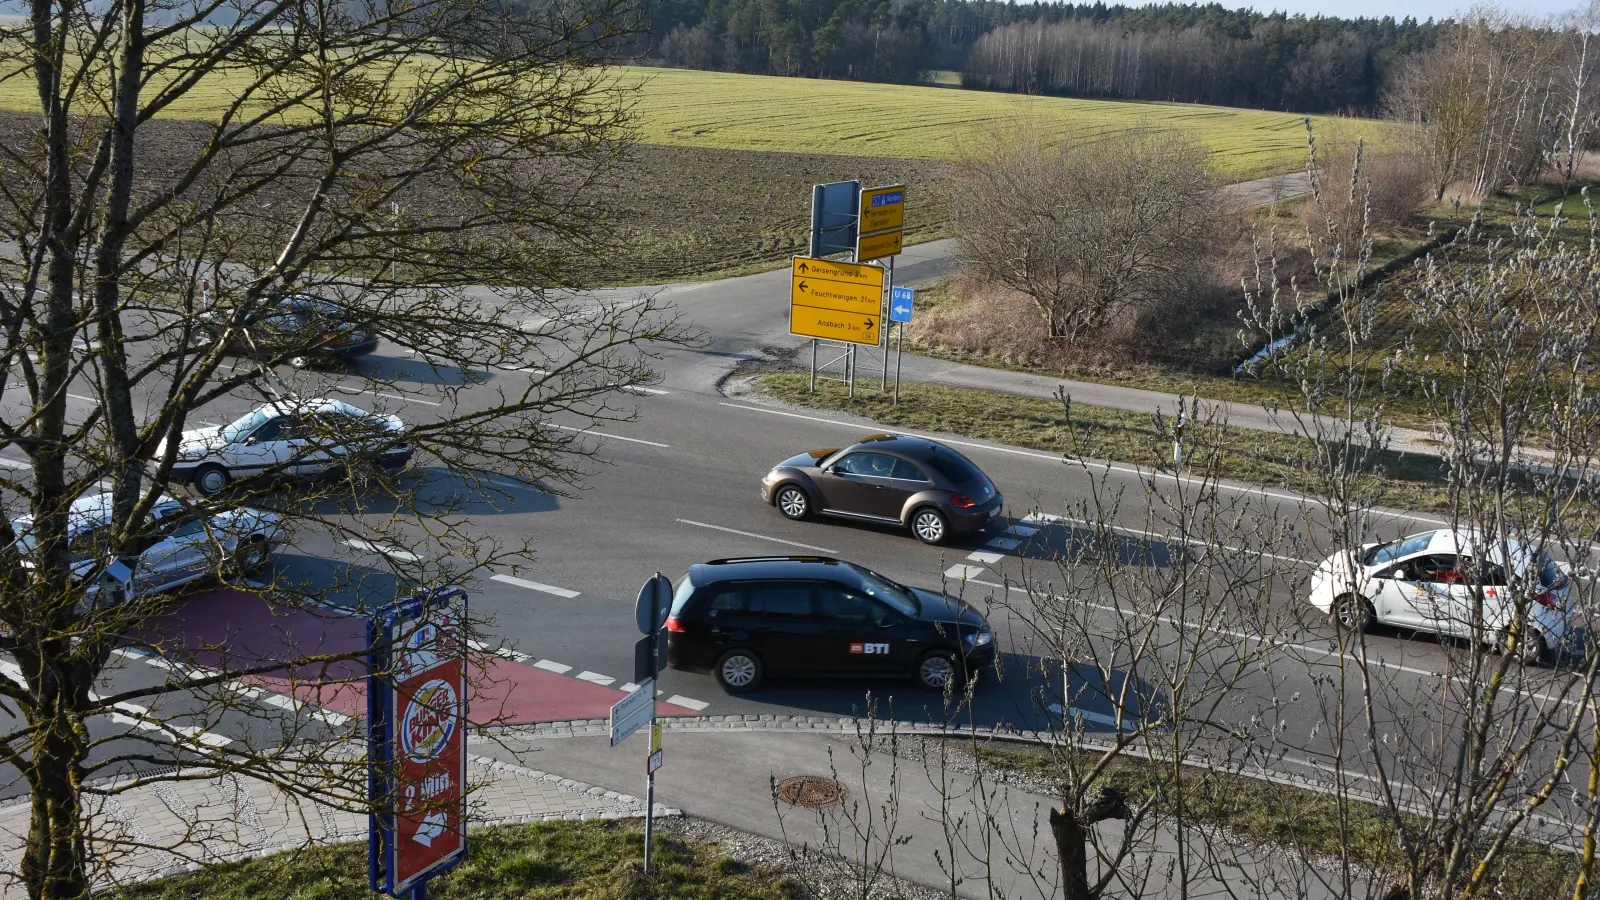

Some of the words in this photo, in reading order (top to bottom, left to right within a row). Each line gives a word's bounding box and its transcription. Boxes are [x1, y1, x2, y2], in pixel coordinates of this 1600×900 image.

[810, 289, 858, 302] Feuchtwangen
[894, 290, 901, 299] U
[817, 319, 845, 329] Ansbach
[864, 642, 890, 654] BTI
